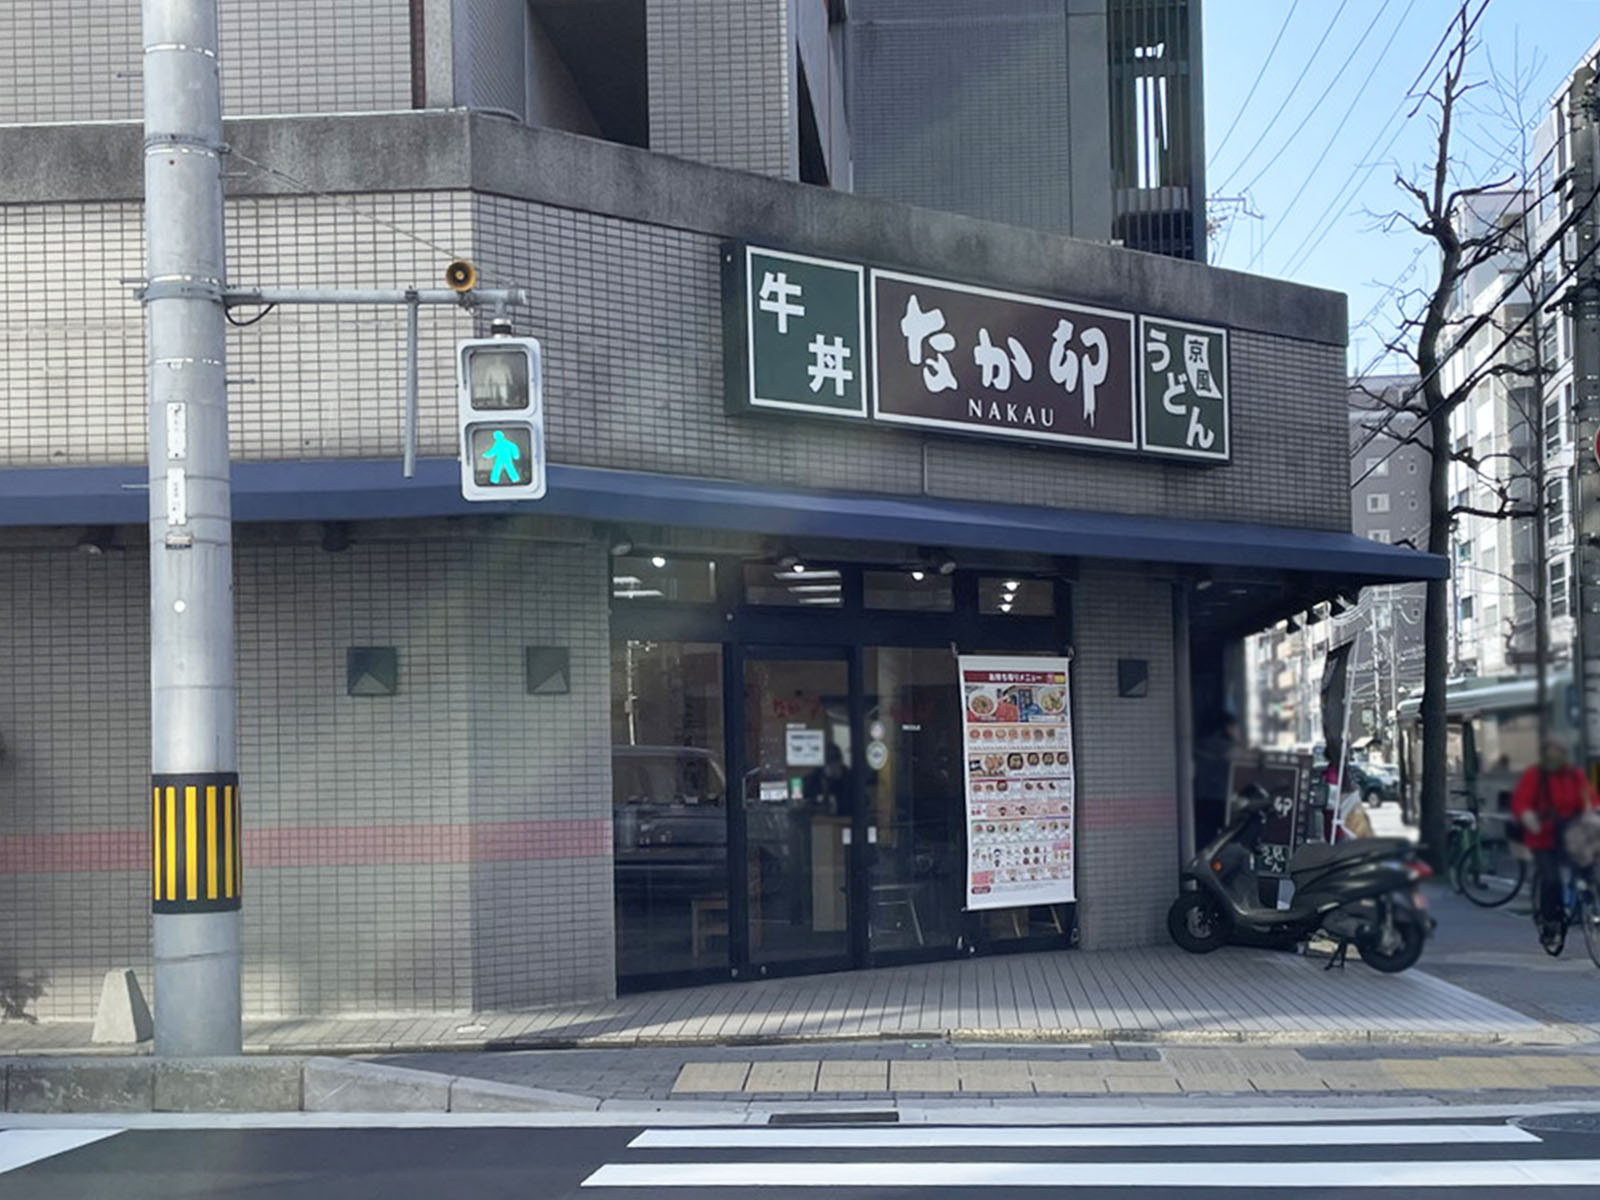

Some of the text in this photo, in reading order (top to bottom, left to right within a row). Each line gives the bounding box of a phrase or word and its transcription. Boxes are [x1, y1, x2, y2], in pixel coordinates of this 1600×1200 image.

[759, 271, 853, 396] 牛丼
[901, 294, 1109, 428] なか卯
[1146, 328, 1215, 449] うどん
[968, 398, 1054, 427] NAKAU
